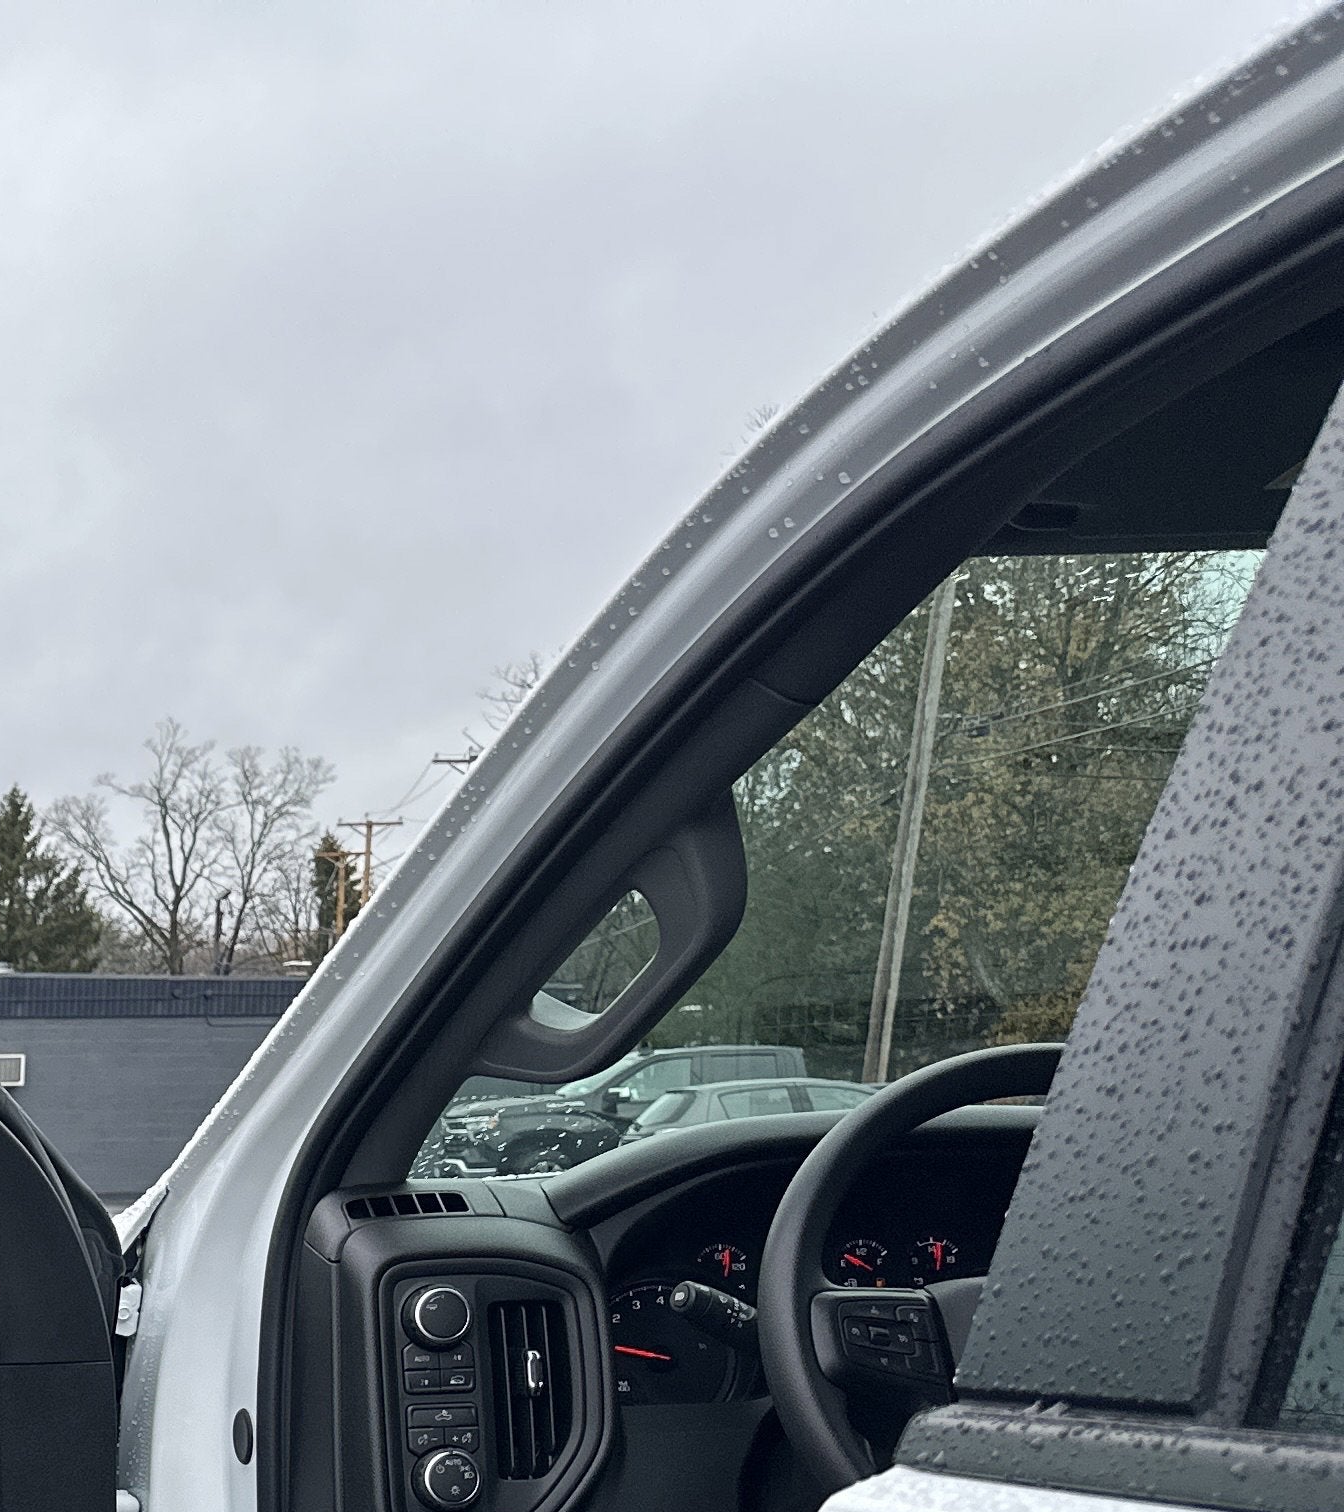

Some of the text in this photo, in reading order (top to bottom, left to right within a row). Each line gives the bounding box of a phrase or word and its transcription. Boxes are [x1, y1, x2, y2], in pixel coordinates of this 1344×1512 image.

[876, 1257, 883, 1265] F
[632, 1300, 641, 1310] 3
[655, 1295, 664, 1305] 4
[612, 1313, 621, 1324] 2
[445, 1458, 462, 1466] AUTO
